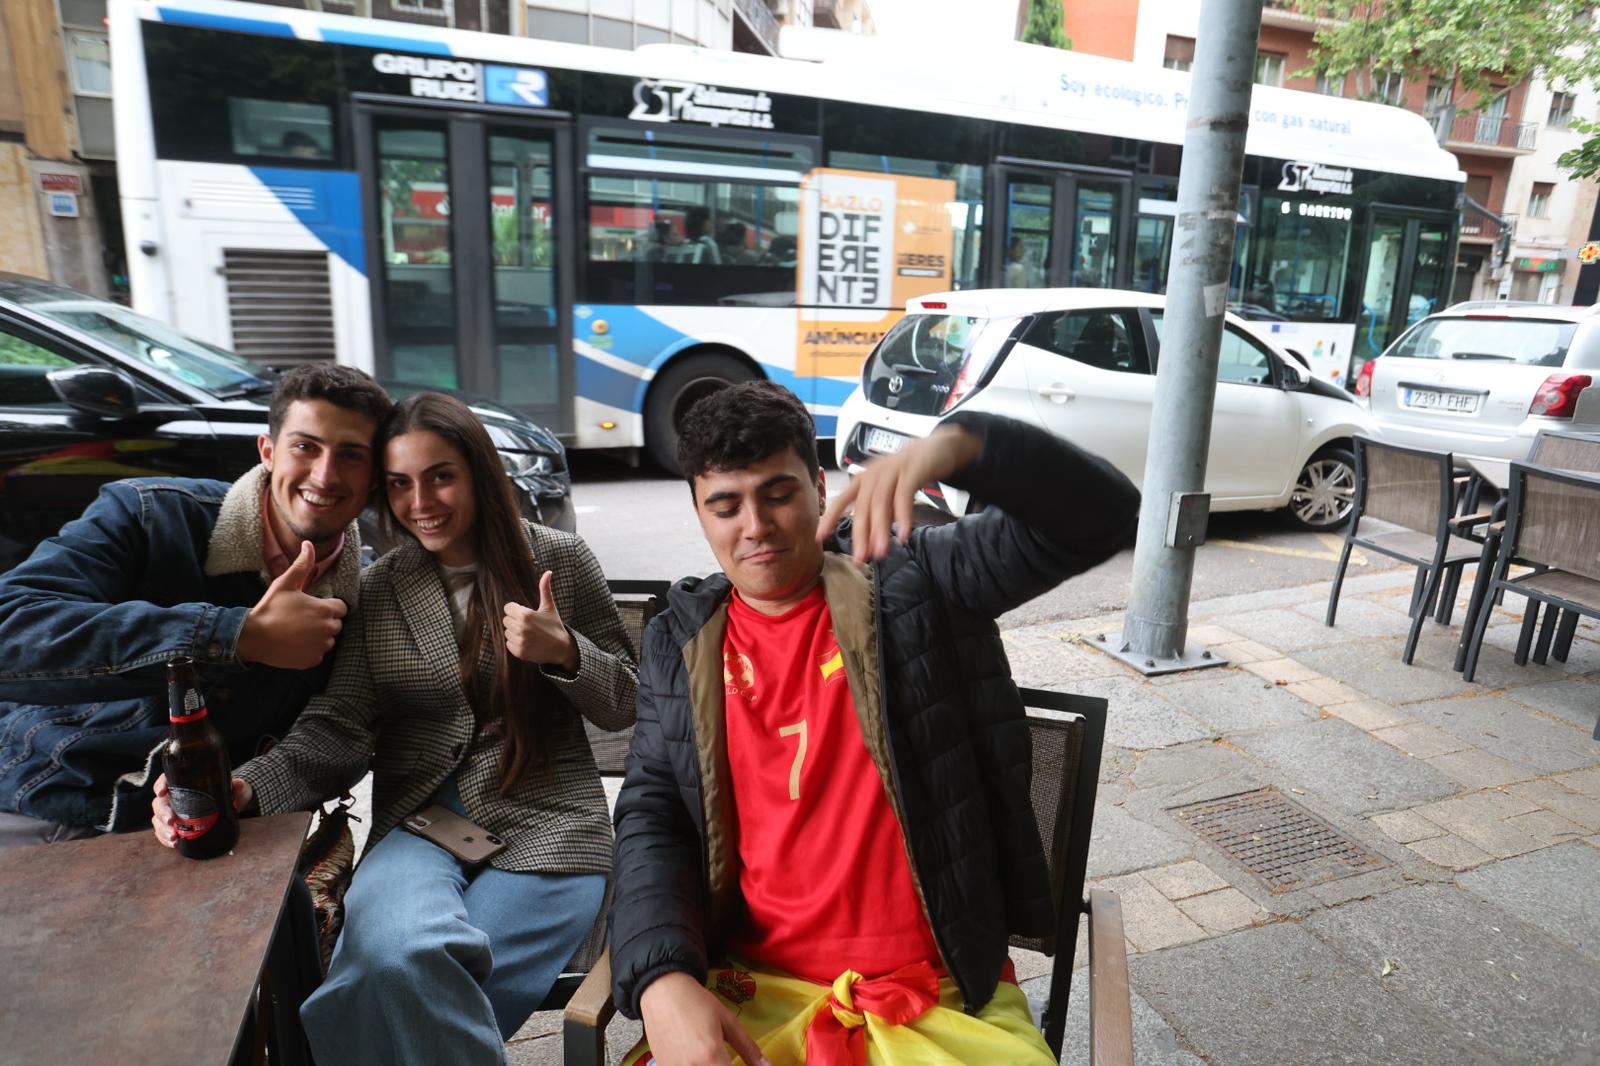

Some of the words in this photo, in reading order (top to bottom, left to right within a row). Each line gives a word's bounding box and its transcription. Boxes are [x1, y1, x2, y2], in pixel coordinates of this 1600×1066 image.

[372, 53, 475, 82] GRUPO
[410, 77, 477, 101] RUIZ
[1060, 74, 1085, 98] Soy
[1255, 109, 1277, 125] con
[1282, 112, 1304, 129] gas
[1308, 116, 1351, 135] natural
[820, 211, 881, 242] DIF
[778, 719, 808, 801] 7
